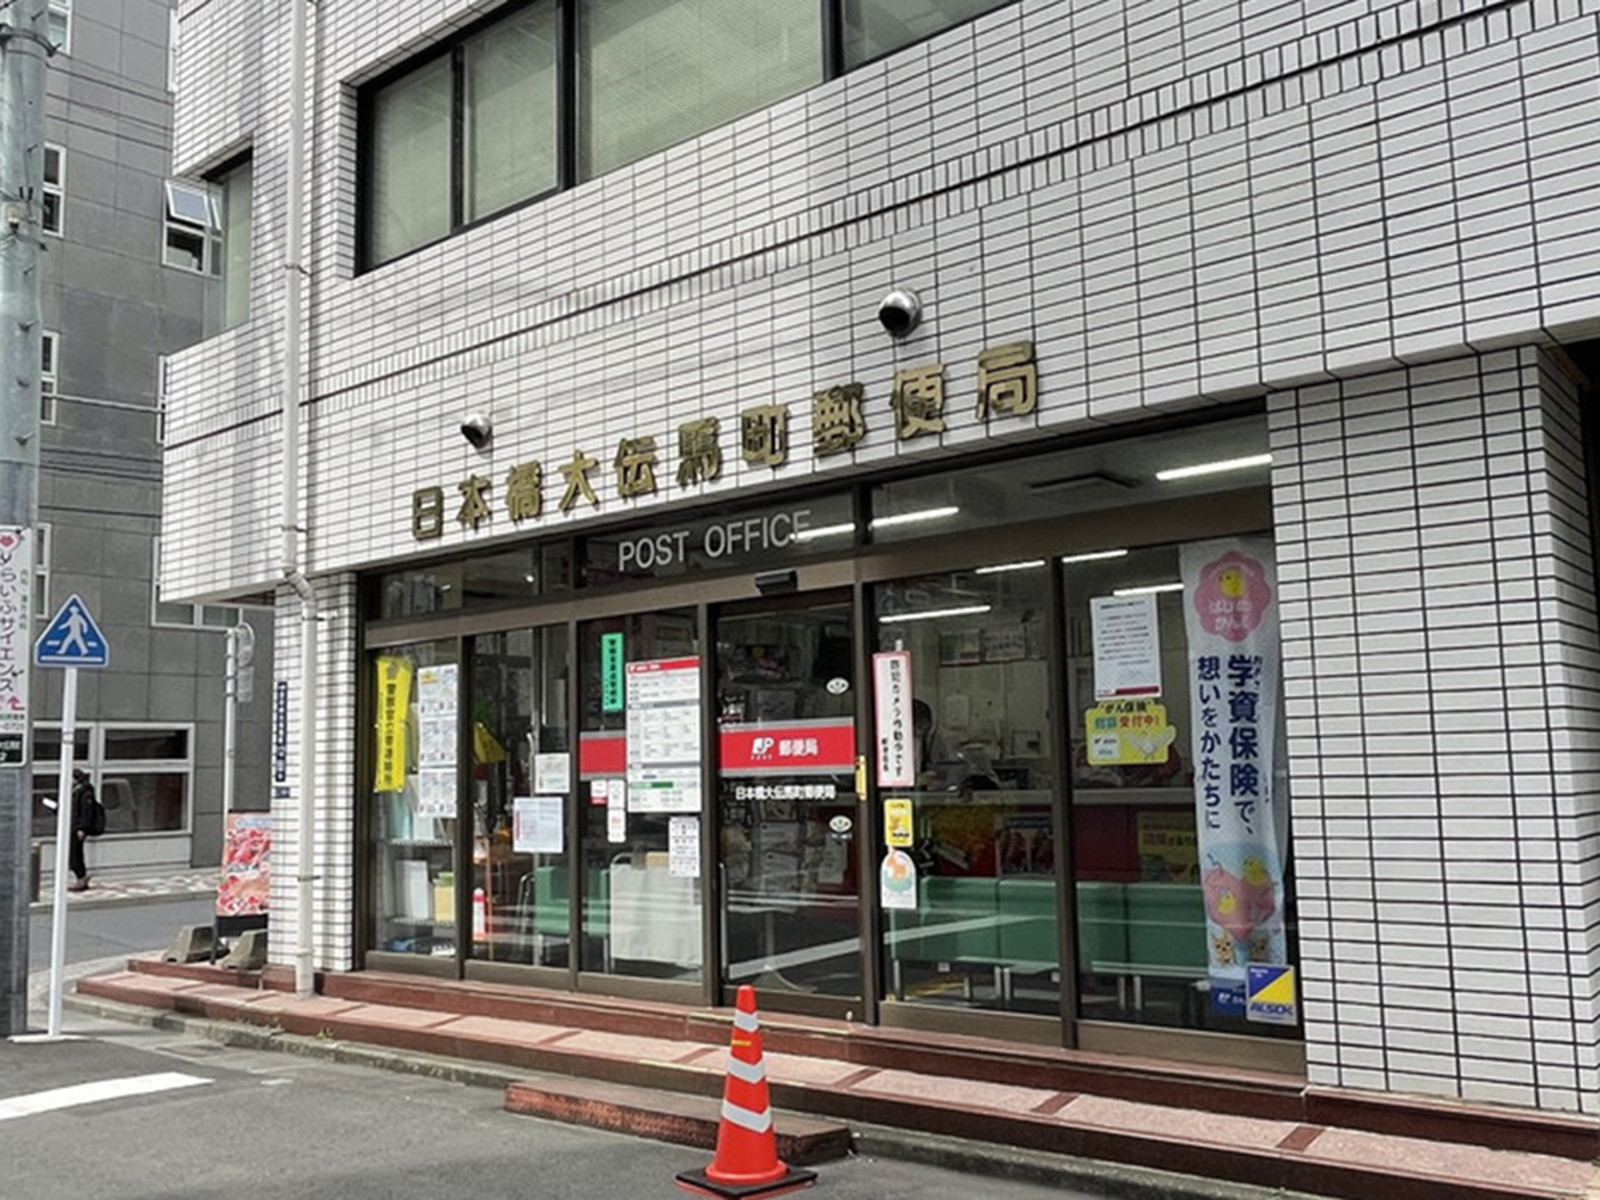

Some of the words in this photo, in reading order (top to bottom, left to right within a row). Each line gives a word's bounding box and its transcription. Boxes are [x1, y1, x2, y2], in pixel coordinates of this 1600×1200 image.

[410, 338, 1041, 542] 日本橋大伝馬町郵便局
[617, 531, 690, 571] POST
[704, 508, 812, 560] OFFICE
[778, 737, 819, 757] 郵便局
[1196, 656, 1223, 830] 想いをかたちに
[1227, 655, 1259, 835] 学資保険で、
